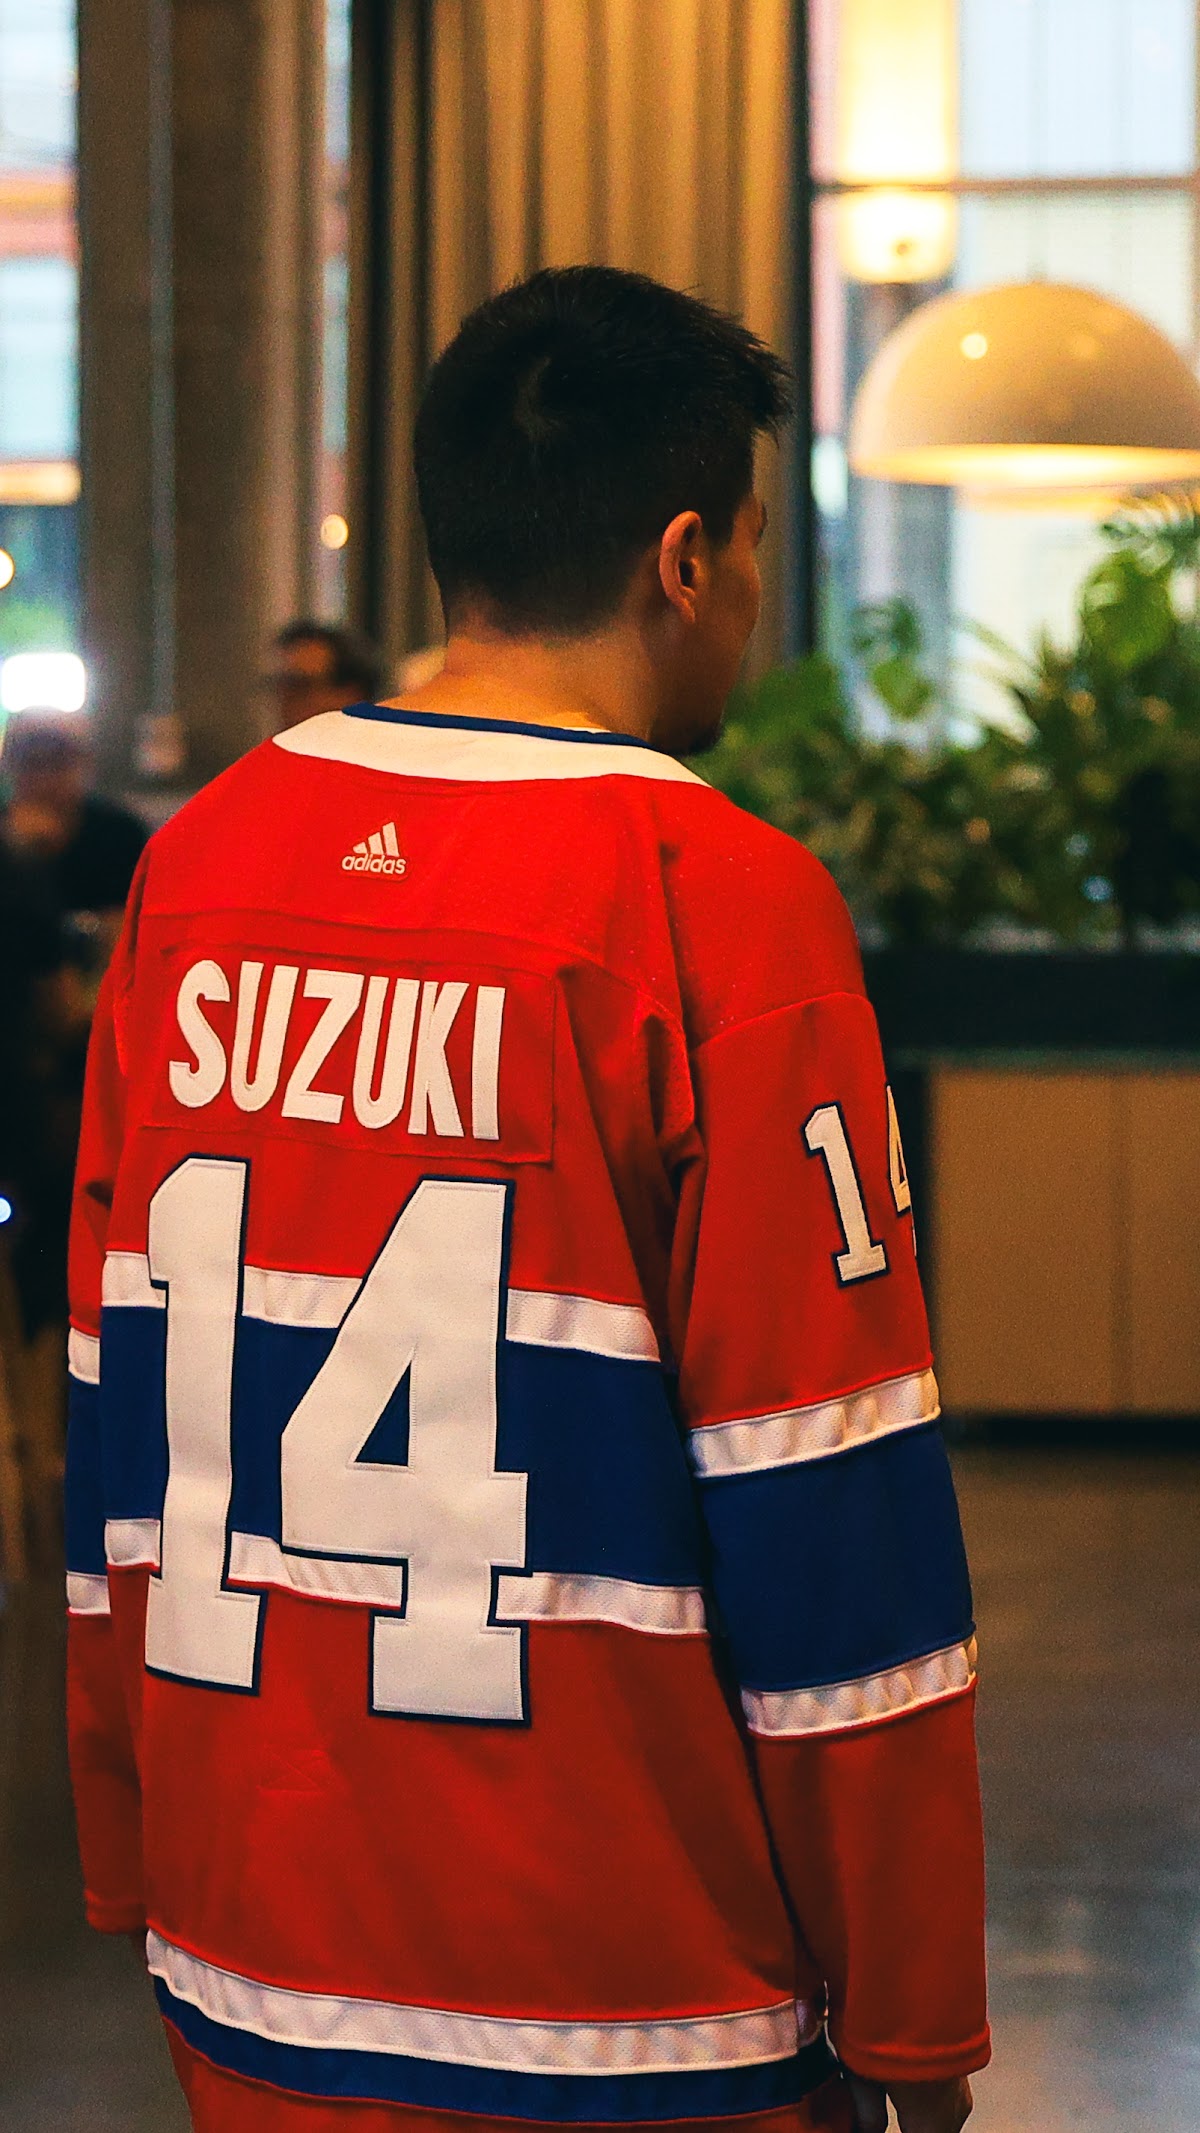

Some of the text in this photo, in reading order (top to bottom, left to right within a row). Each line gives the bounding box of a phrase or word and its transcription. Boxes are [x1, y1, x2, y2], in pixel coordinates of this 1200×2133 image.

[341, 853, 407, 875] adidas
[168, 959, 506, 1141] SUZUKI
[145, 1153, 532, 1728] 14
